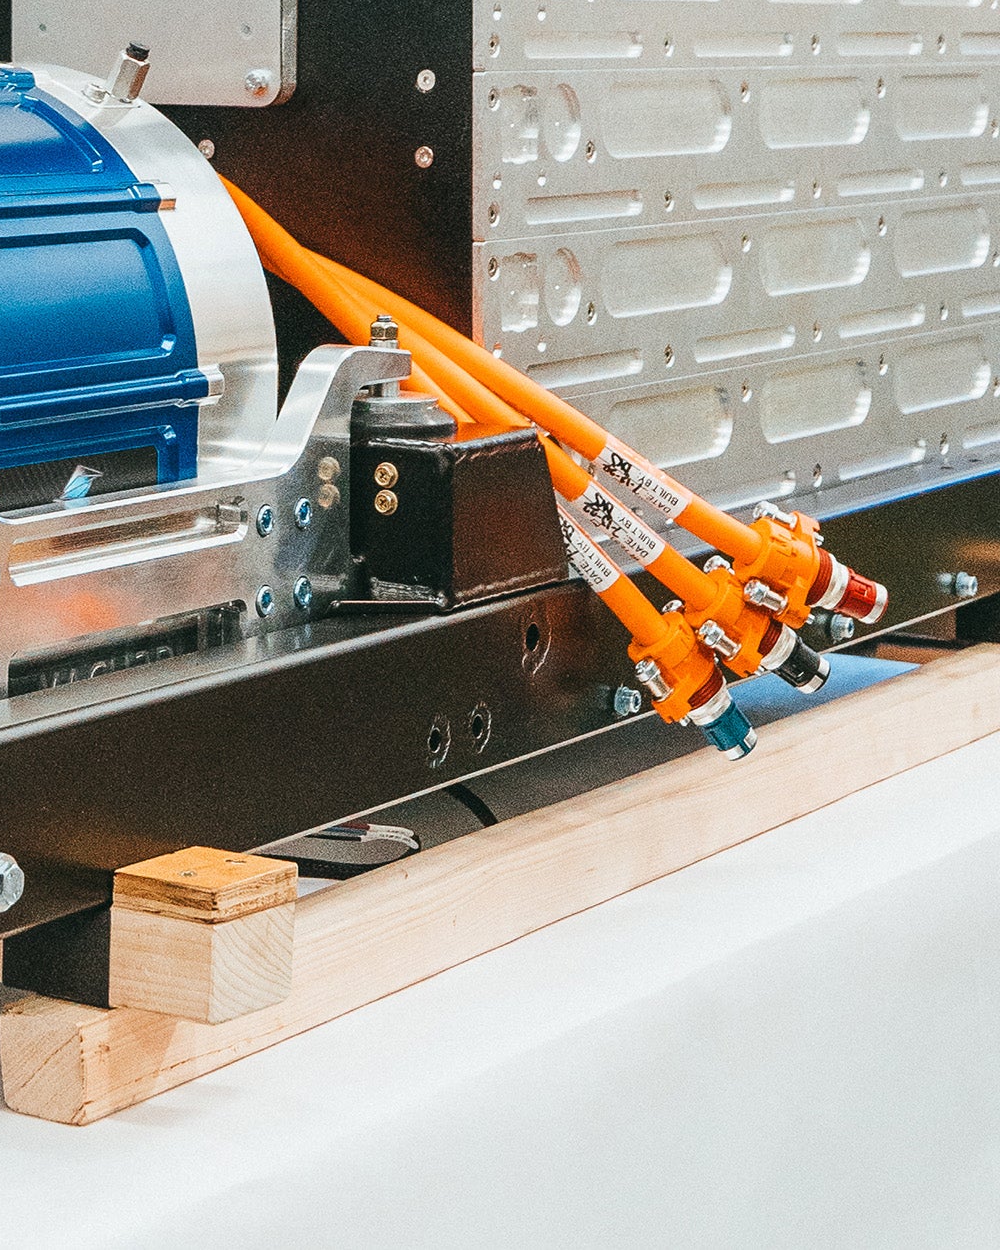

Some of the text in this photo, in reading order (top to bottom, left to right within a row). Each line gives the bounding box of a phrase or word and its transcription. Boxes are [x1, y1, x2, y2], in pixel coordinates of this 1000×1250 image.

[652, 484, 679, 506] BUILT
[624, 534, 649, 558] DATE:
[631, 527, 657, 550] BUILT
[580, 559, 603, 584] DATE:
[588, 553, 612, 577] BUILT
